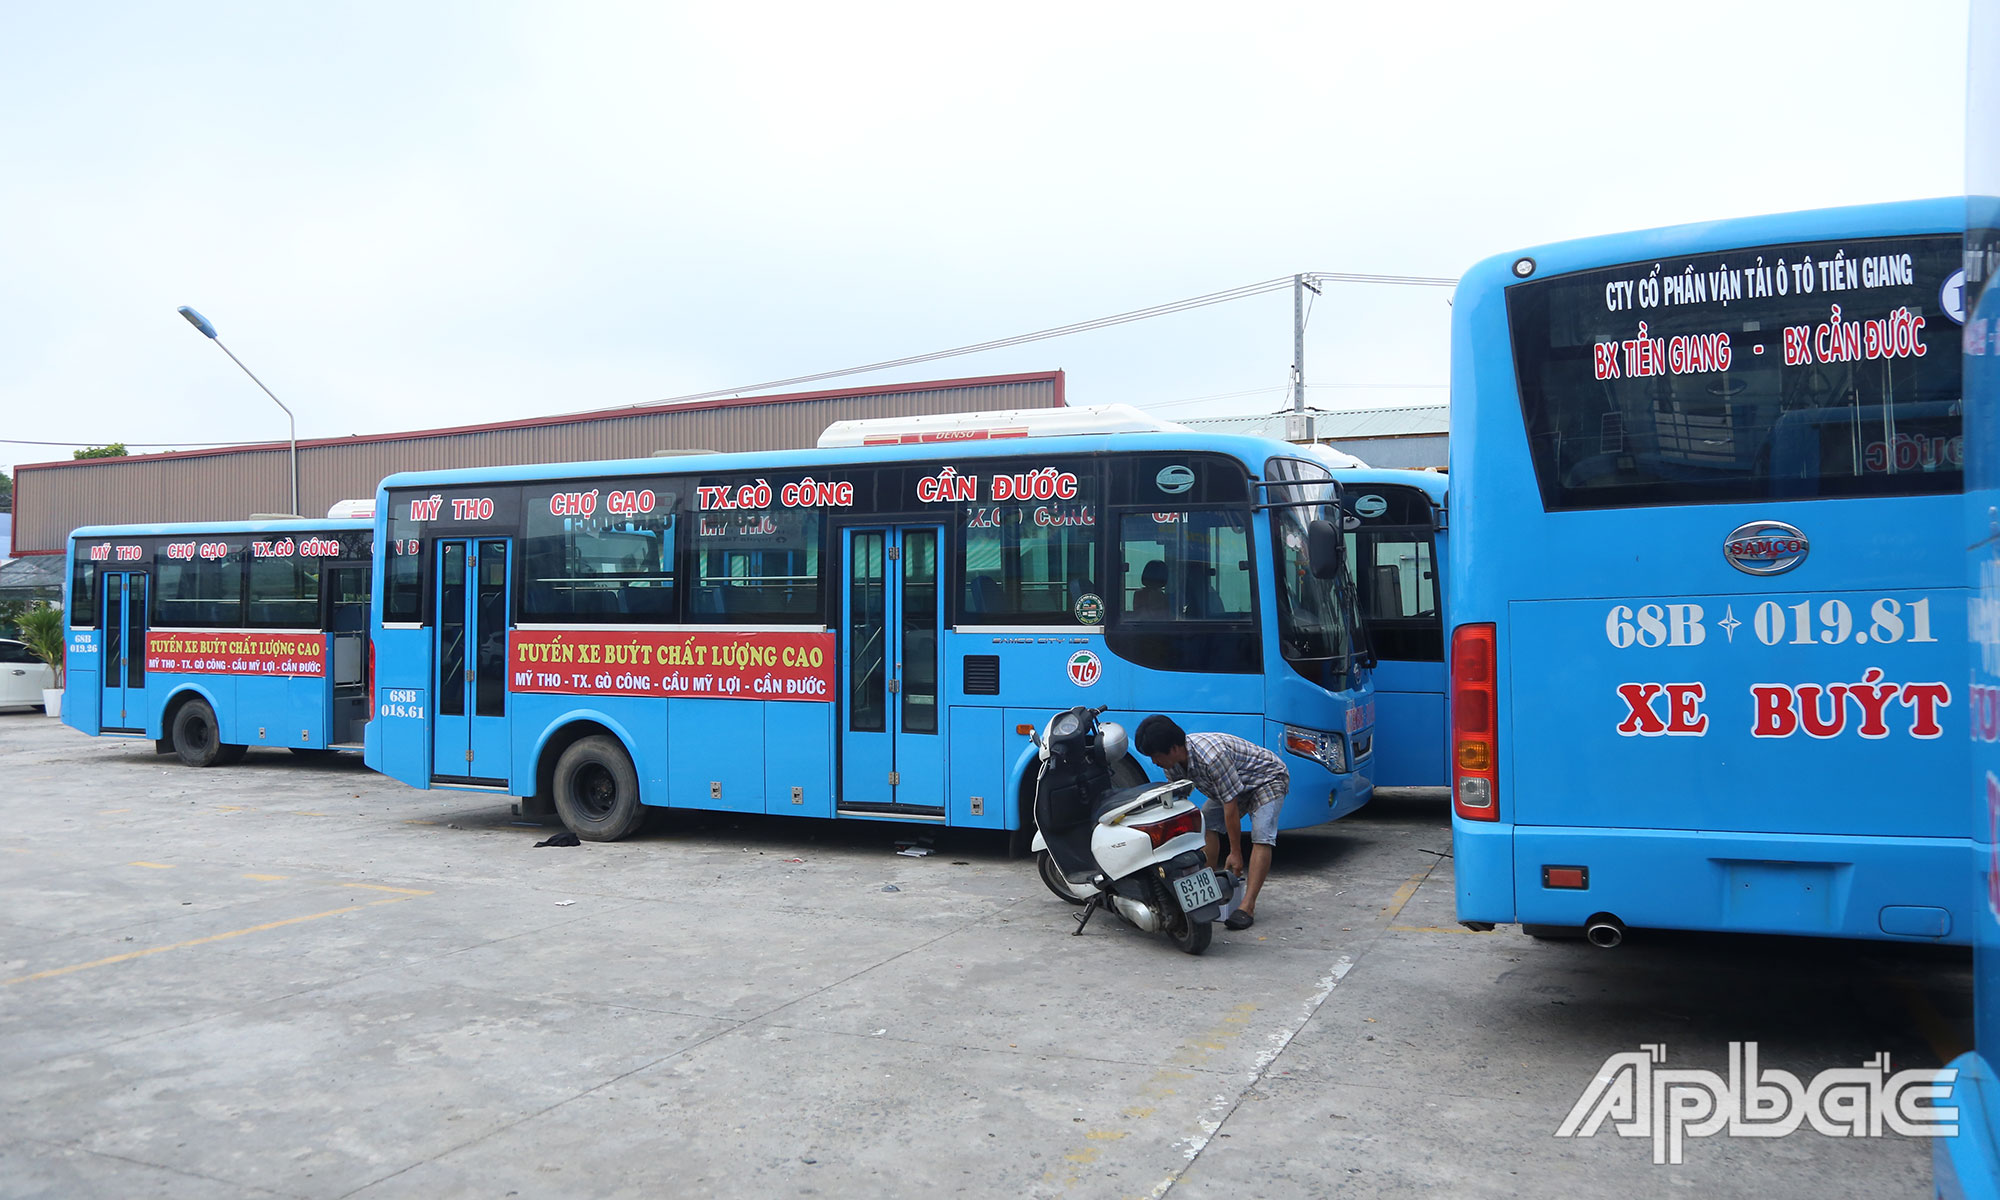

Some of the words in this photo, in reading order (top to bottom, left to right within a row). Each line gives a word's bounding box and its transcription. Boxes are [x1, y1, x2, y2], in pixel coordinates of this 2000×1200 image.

[1606, 280, 1634, 311] CTY
[1638, 263, 1661, 309] CỔ
[1663, 264, 1707, 306] PHẦN
[1709, 263, 1742, 307] VẬN
[1744, 256, 1773, 298] TẢI
[1776, 258, 1788, 296] Ô
[1791, 255, 1814, 294] TÔ
[1818, 249, 1858, 292] TIỀN
[1862, 253, 1913, 289] GIANG
[1594, 341, 1620, 379] BX
[1622, 320, 1666, 378] TIỀN
[1668, 332, 1732, 375] GIANG
[1783, 325, 1812, 366] BX
[1815, 303, 1861, 364] CẦN
[1864, 305, 1927, 360] ĐƯỚC
[936, 430, 975, 440] DENSO
[410, 494, 443, 522] MỸ
[451, 498, 495, 520] THO
[550, 489, 600, 519] CHỢ
[607, 490, 656, 518] GẠO
[697, 478, 772, 510] TX.GÒ
[781, 476, 854, 507] CÔNG
[917, 466, 977, 503] CẦN
[991, 466, 1078, 501] ĐƯỚC
[91, 544, 111, 560] MỸ
[116, 545, 142, 560] THO
[167, 541, 197, 561] CHỢ
[200, 542, 227, 561] GẠO
[252, 537, 295, 558] TX.GÒ
[299, 537, 340, 557] CÔNG
[1731, 540, 1801, 556] SAMCO
[1605, 603, 1706, 648] 68B
[1754, 597, 1938, 645] 019.81
[74, 634, 92, 643] 68B
[150, 635, 183, 653] TUYẾN
[184, 640, 198, 653] XE
[200, 637, 227, 654] BUÝT
[229, 635, 258, 655] CHẤT
[259, 640, 295, 657] LƯỢNG
[297, 642, 320, 655] CAO
[517, 634, 574, 663] TUYẾN
[577, 644, 601, 663] XE
[604, 639, 652, 665] BUÝT
[656, 635, 707, 666] CHẤT
[711, 641, 777, 671] LƯỢNG
[782, 646, 823, 668] CAO
[161, 659, 175, 668] THO
[182, 660, 192, 669] TX.
[194, 658, 204, 669] GÒ
[206, 658, 226, 670] CÔNG
[249, 660, 260, 671] MỸ
[262, 661, 275, 672] LỢI
[299, 662, 321, 673] ĐƯỚC
[515, 669, 533, 686] MỸ
[537, 672, 561, 687] THO
[572, 674, 592, 688] TX.
[595, 671, 612, 689] GÒ
[615, 672, 651, 690] CÔNG
[662, 670, 689, 691] CẦU
[693, 673, 713, 691] MỸ
[718, 675, 741, 695] LỢI
[753, 672, 782, 693] CẦN
[786, 675, 827, 695] ĐƯỚC
[389, 689, 416, 703] 68B
[1616, 681, 1710, 737] XE
[1750, 666, 1952, 740] BUÝT
[381, 704, 424, 720] 018.61
[1180, 872, 1210, 894] 63-H8
[1185, 886, 1216, 908] 5728
